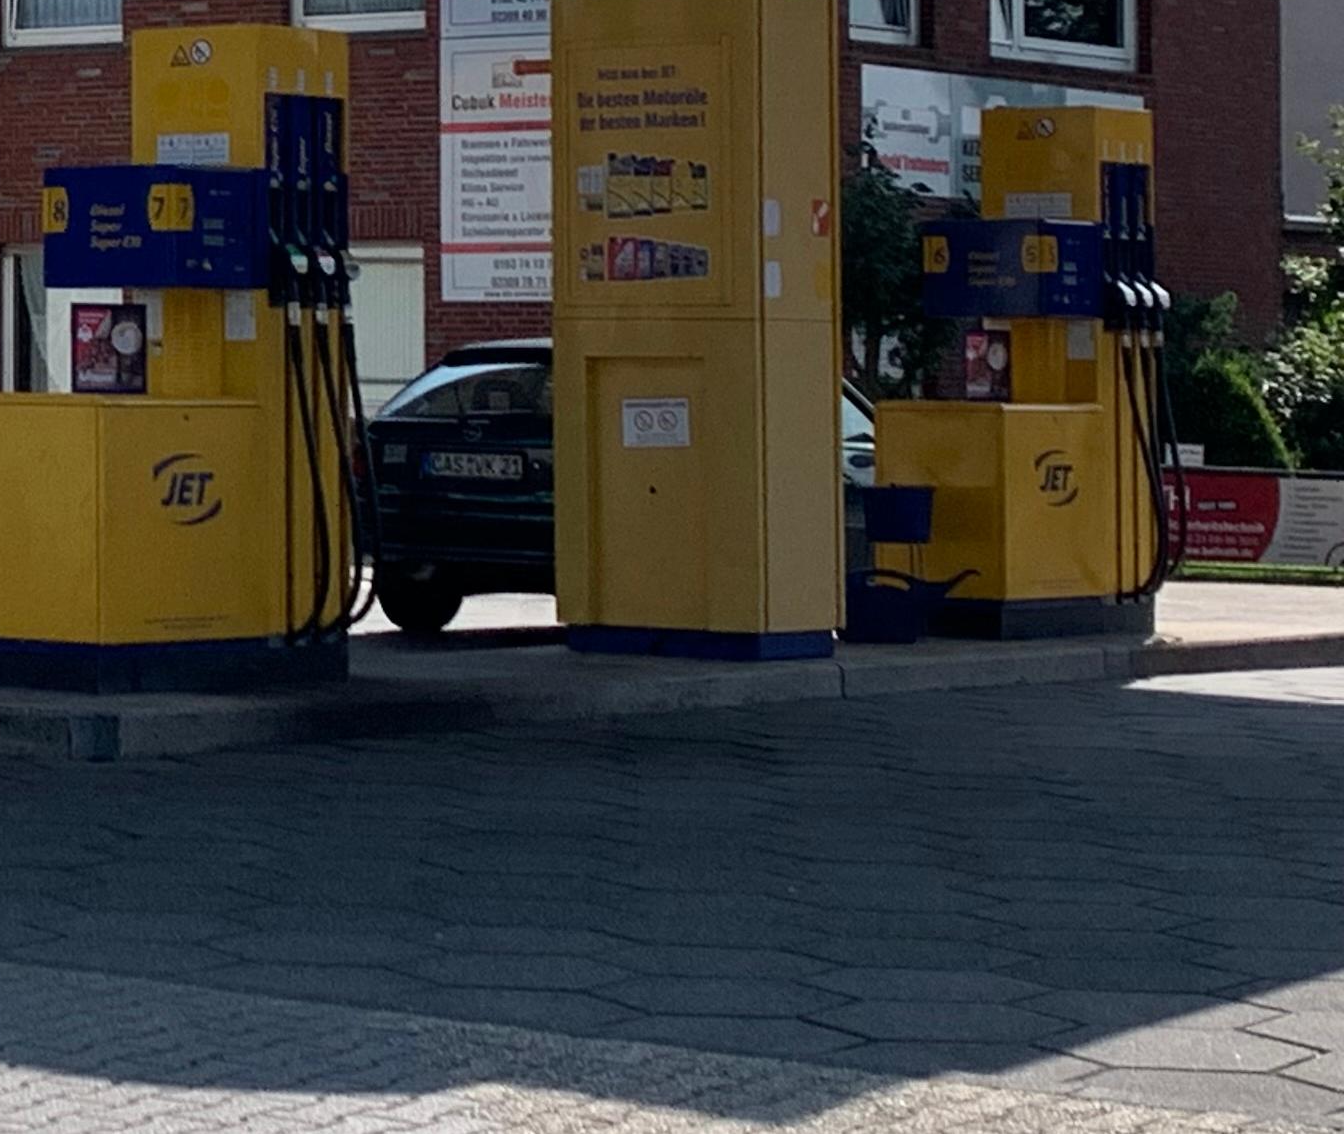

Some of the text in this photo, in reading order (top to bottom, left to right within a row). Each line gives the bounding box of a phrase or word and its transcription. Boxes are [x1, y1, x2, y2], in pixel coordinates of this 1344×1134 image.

[53, 199, 66, 222] 8
[152, 196, 166, 222] 7
[161, 471, 215, 507] JET
[1039, 464, 1073, 493] JET
